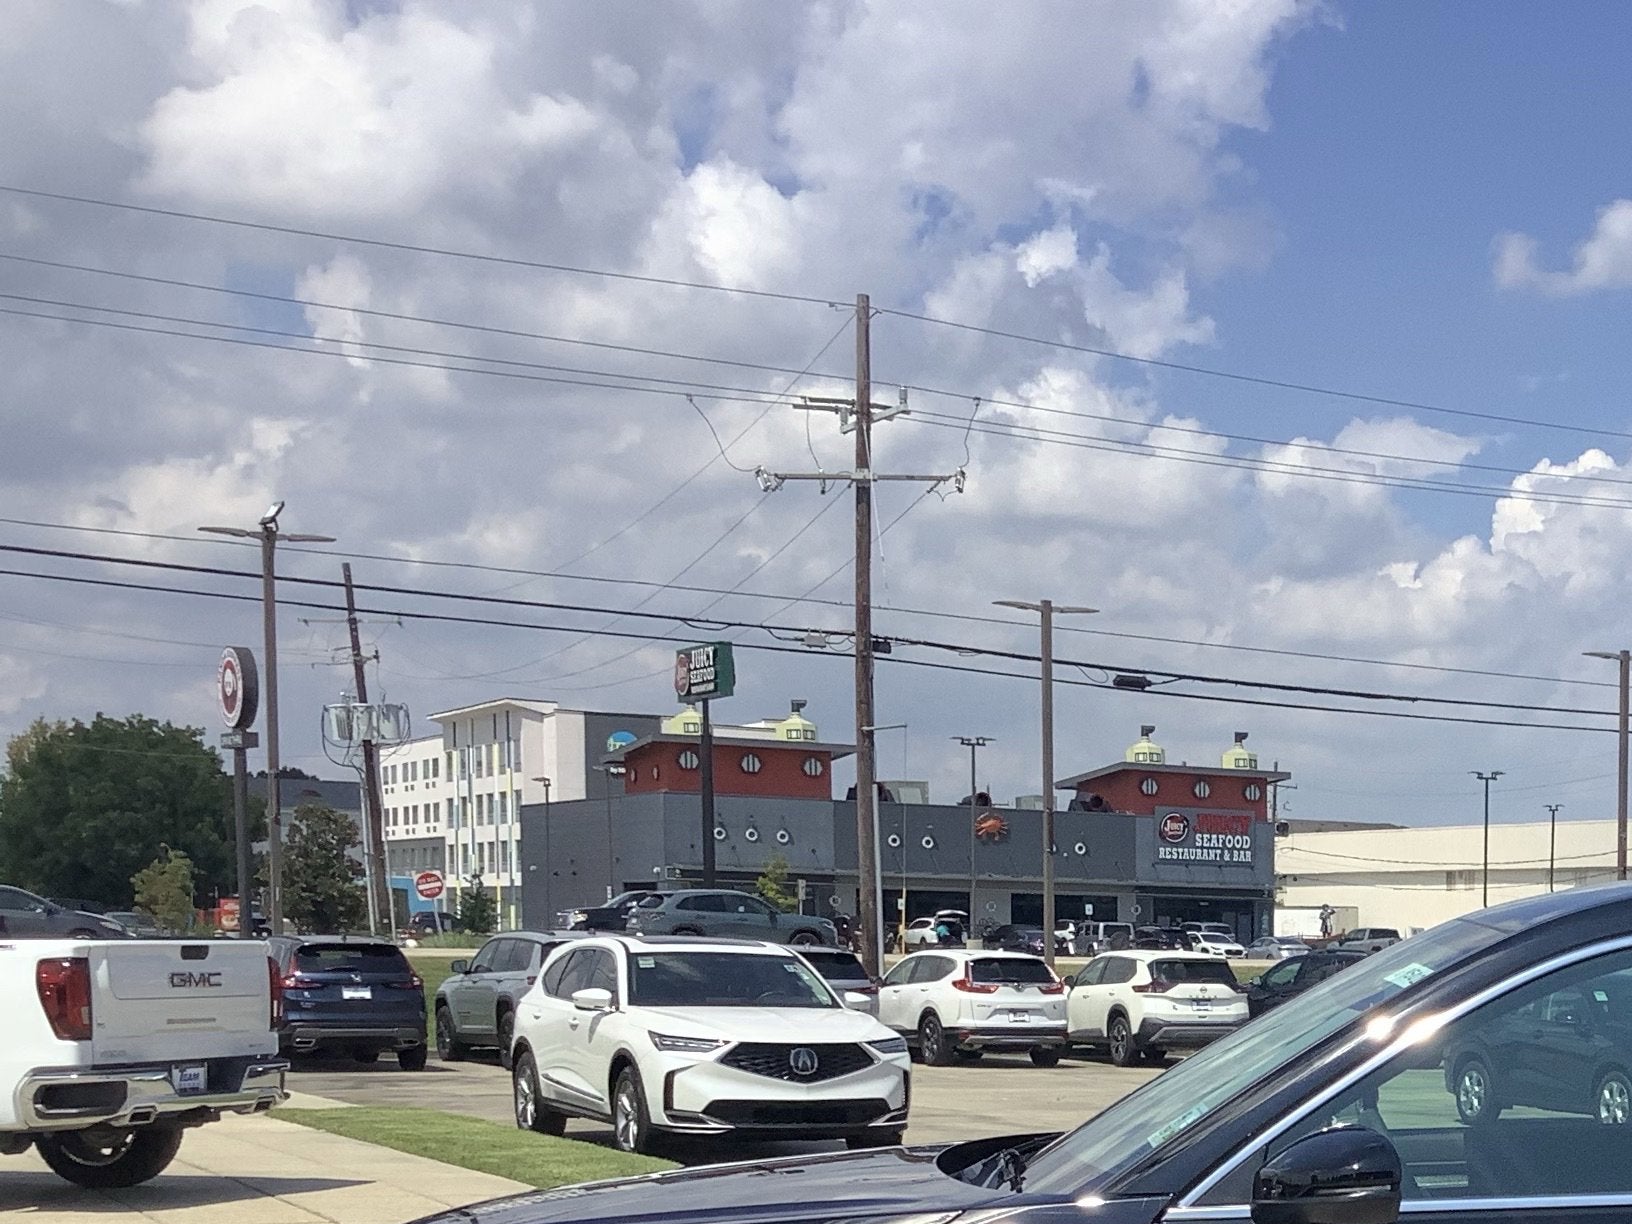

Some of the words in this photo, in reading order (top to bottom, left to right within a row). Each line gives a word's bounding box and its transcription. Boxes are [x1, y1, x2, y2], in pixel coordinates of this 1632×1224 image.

[1195, 834, 1251, 849] SEAFOOD
[1159, 847, 1221, 861] RESTAURANT
[1224, 850, 1231, 861] &
[1233, 850, 1252, 862] BAR
[170, 972, 222, 988] GMC
